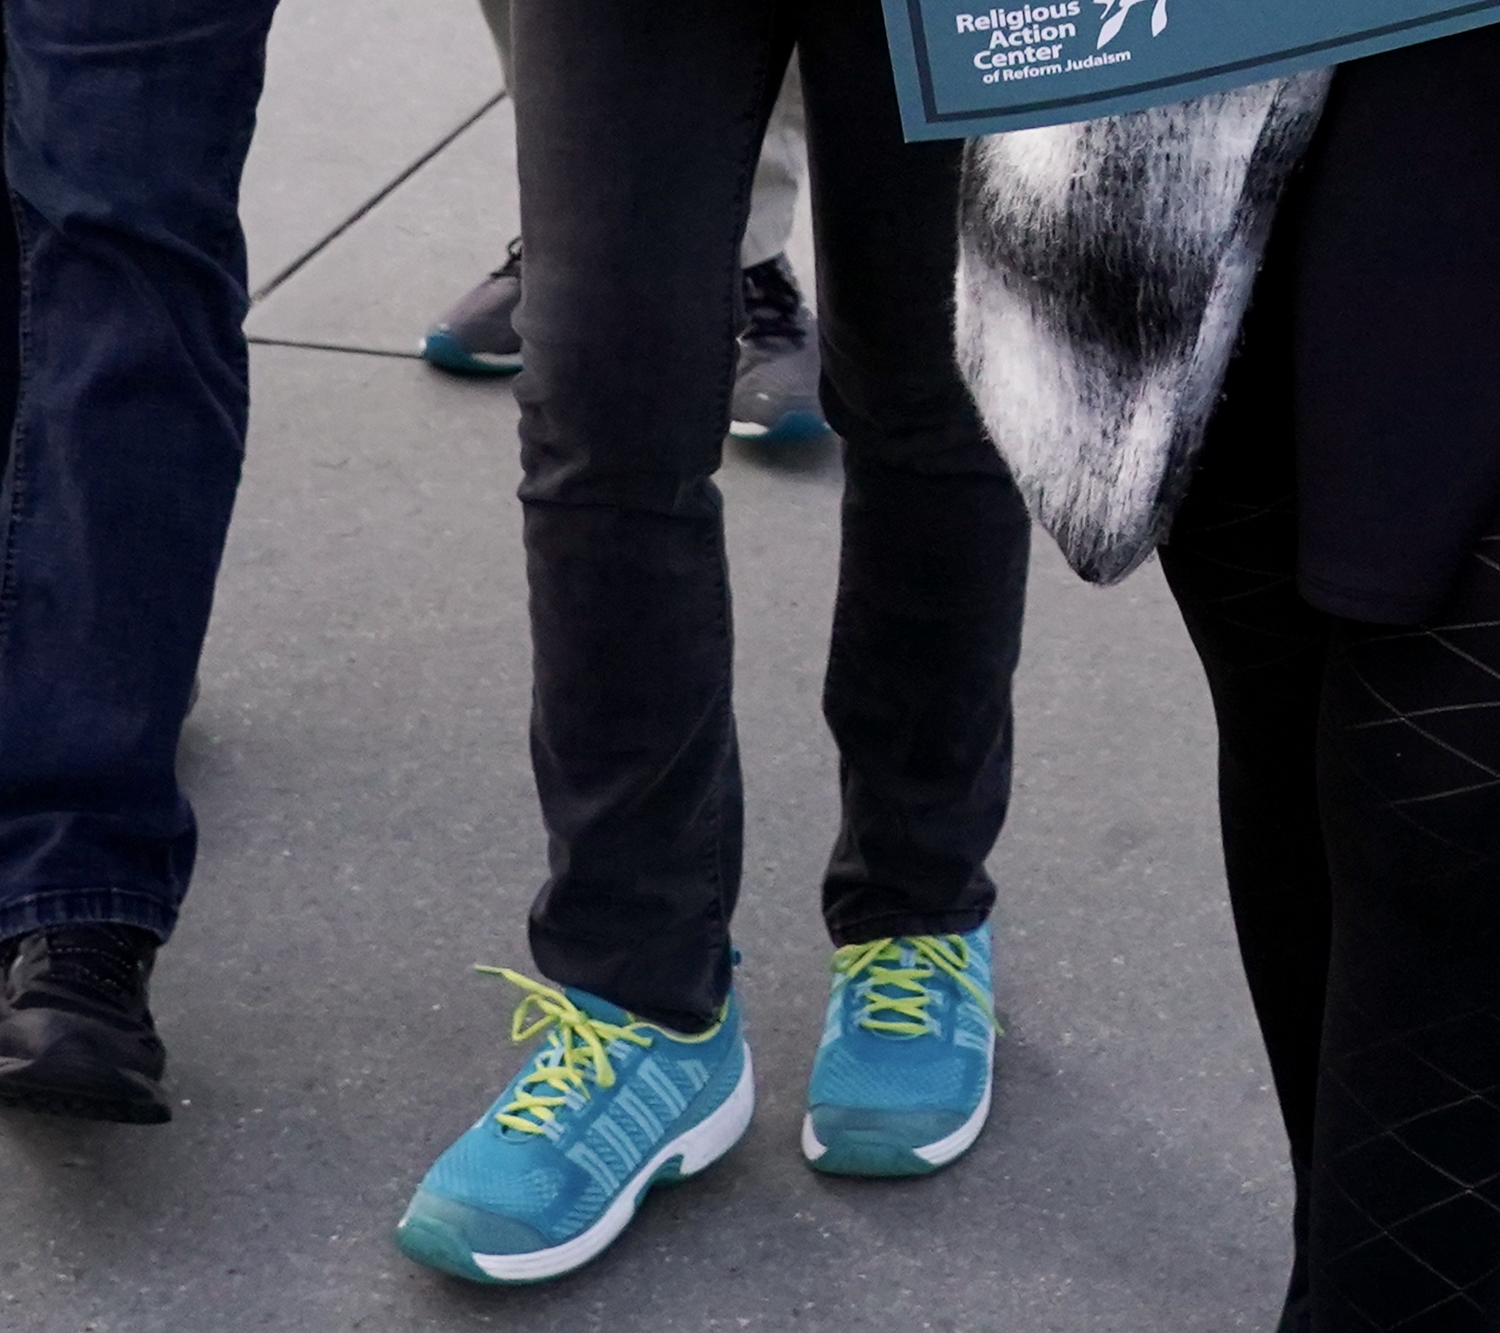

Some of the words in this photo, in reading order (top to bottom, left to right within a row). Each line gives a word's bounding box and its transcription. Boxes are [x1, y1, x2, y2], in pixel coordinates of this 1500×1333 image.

[956, 0, 1080, 33] Religious
[989, 22, 1076, 49] Action
[974, 43, 1063, 70] Center
[983, 68, 1000, 84] of
[1003, 63, 1062, 81] Reform
[1064, 50, 1131, 73] Judaism
